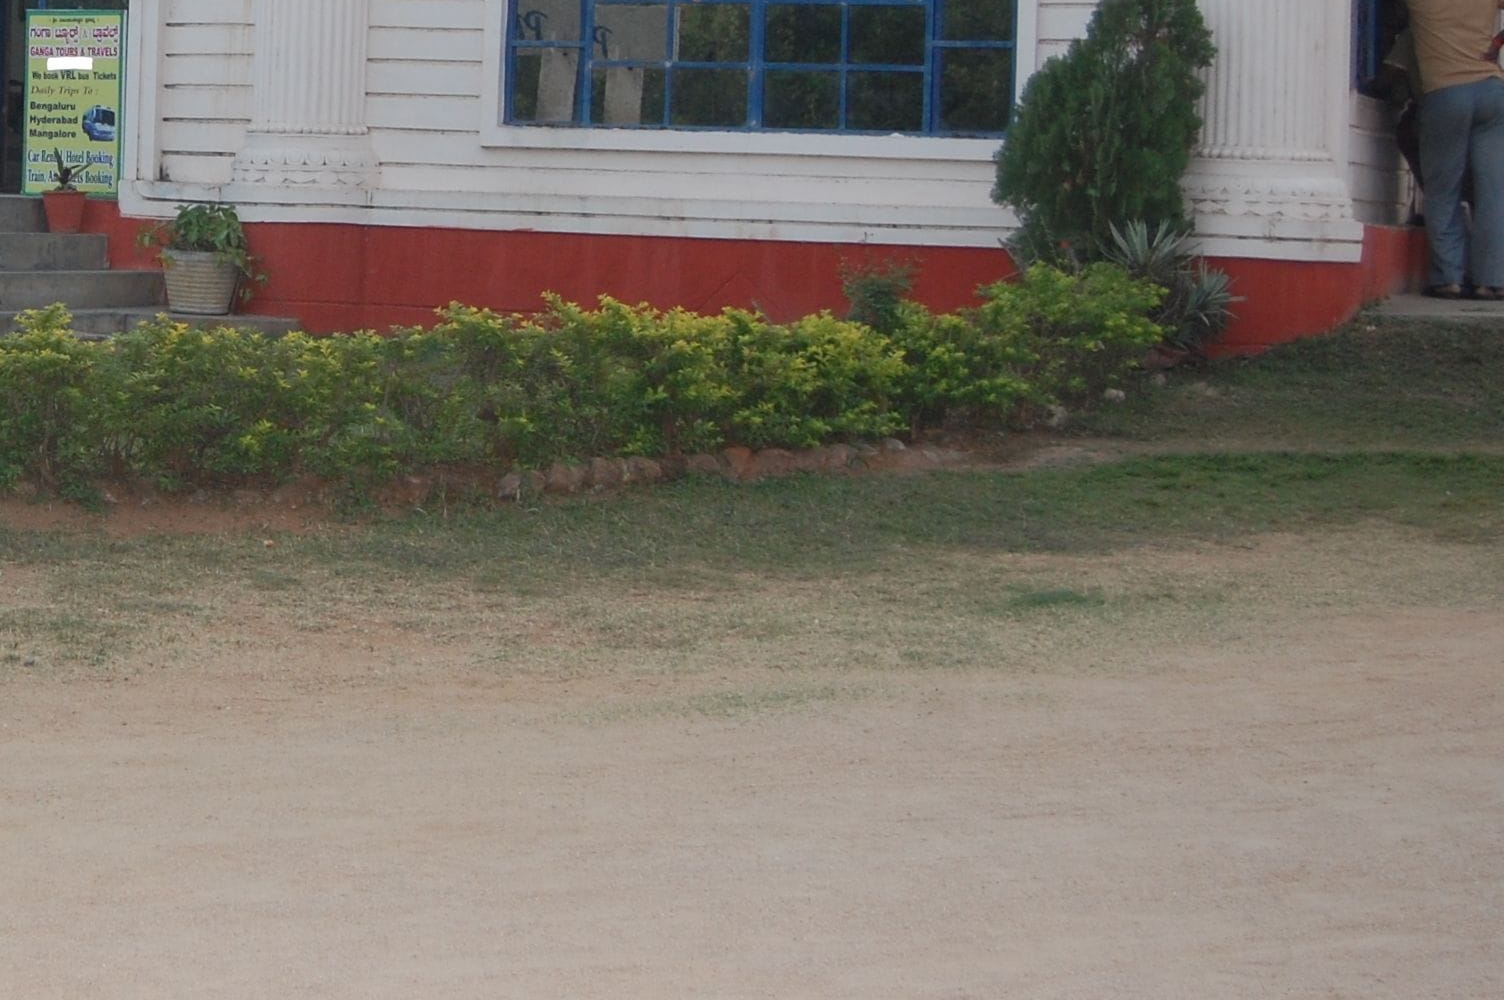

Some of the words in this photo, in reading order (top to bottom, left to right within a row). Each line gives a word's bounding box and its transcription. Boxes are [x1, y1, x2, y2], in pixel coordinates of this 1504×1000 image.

[30, 47, 54, 56] GANGA
[56, 47, 78, 56] TOURS
[80, 47, 85, 56] &
[87, 47, 118, 56] TRAVELS
[32, 72, 42, 80] We
[43, 72, 58, 80] book
[61, 70, 77, 80] VRL
[78, 72, 89, 80] bus
[93, 72, 117, 80] Tickets
[31, 86, 54, 97] Daily
[59, 86, 79, 96] Trips
[30, 101, 76, 111] Bengaluru
[29, 115, 78, 125] Hyderabad
[29, 129, 76, 140] Mangalore
[28, 149, 39, 162] Car
[66, 150, 84, 163] Hotel
[86, 151, 113, 168] Booking
[85, 171, 113, 188] Booking
